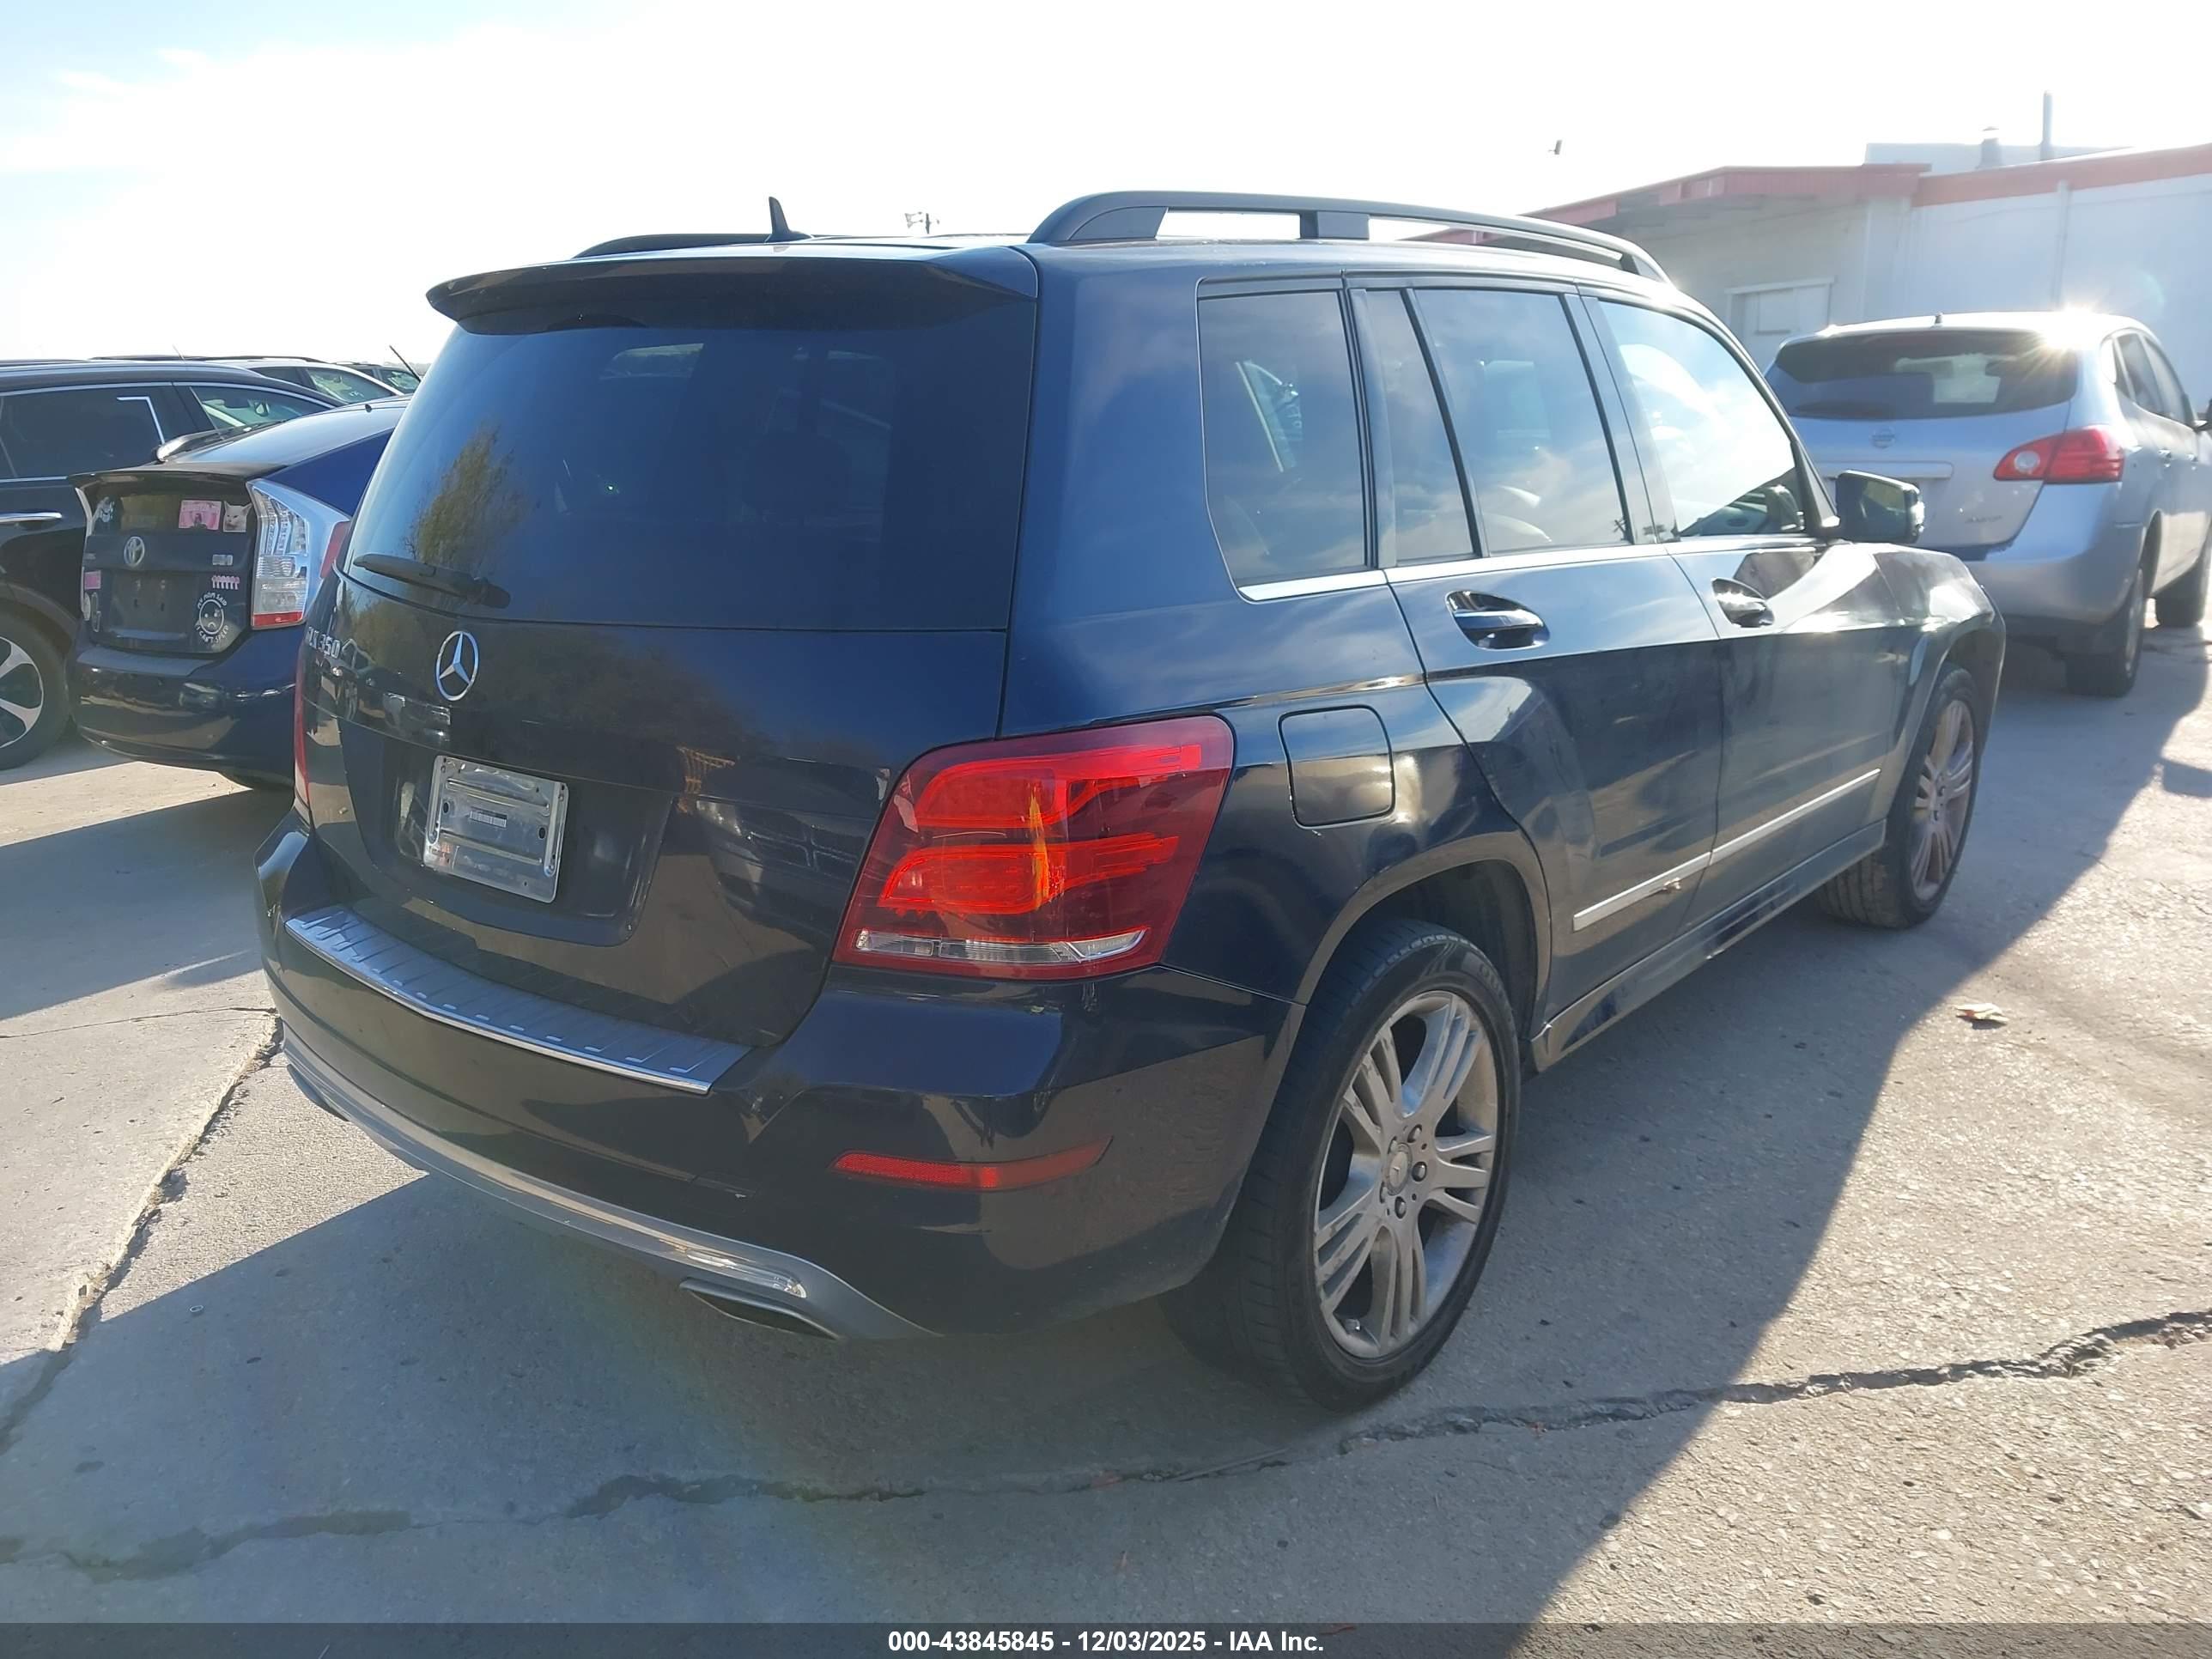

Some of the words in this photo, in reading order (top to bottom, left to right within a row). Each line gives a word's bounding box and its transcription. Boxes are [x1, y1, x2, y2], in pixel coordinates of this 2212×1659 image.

[204, 592, 216, 600] MOM
[216, 593, 228, 606] SAID
[215, 624, 229, 643] SPEED
[318, 634, 341, 659] 350
